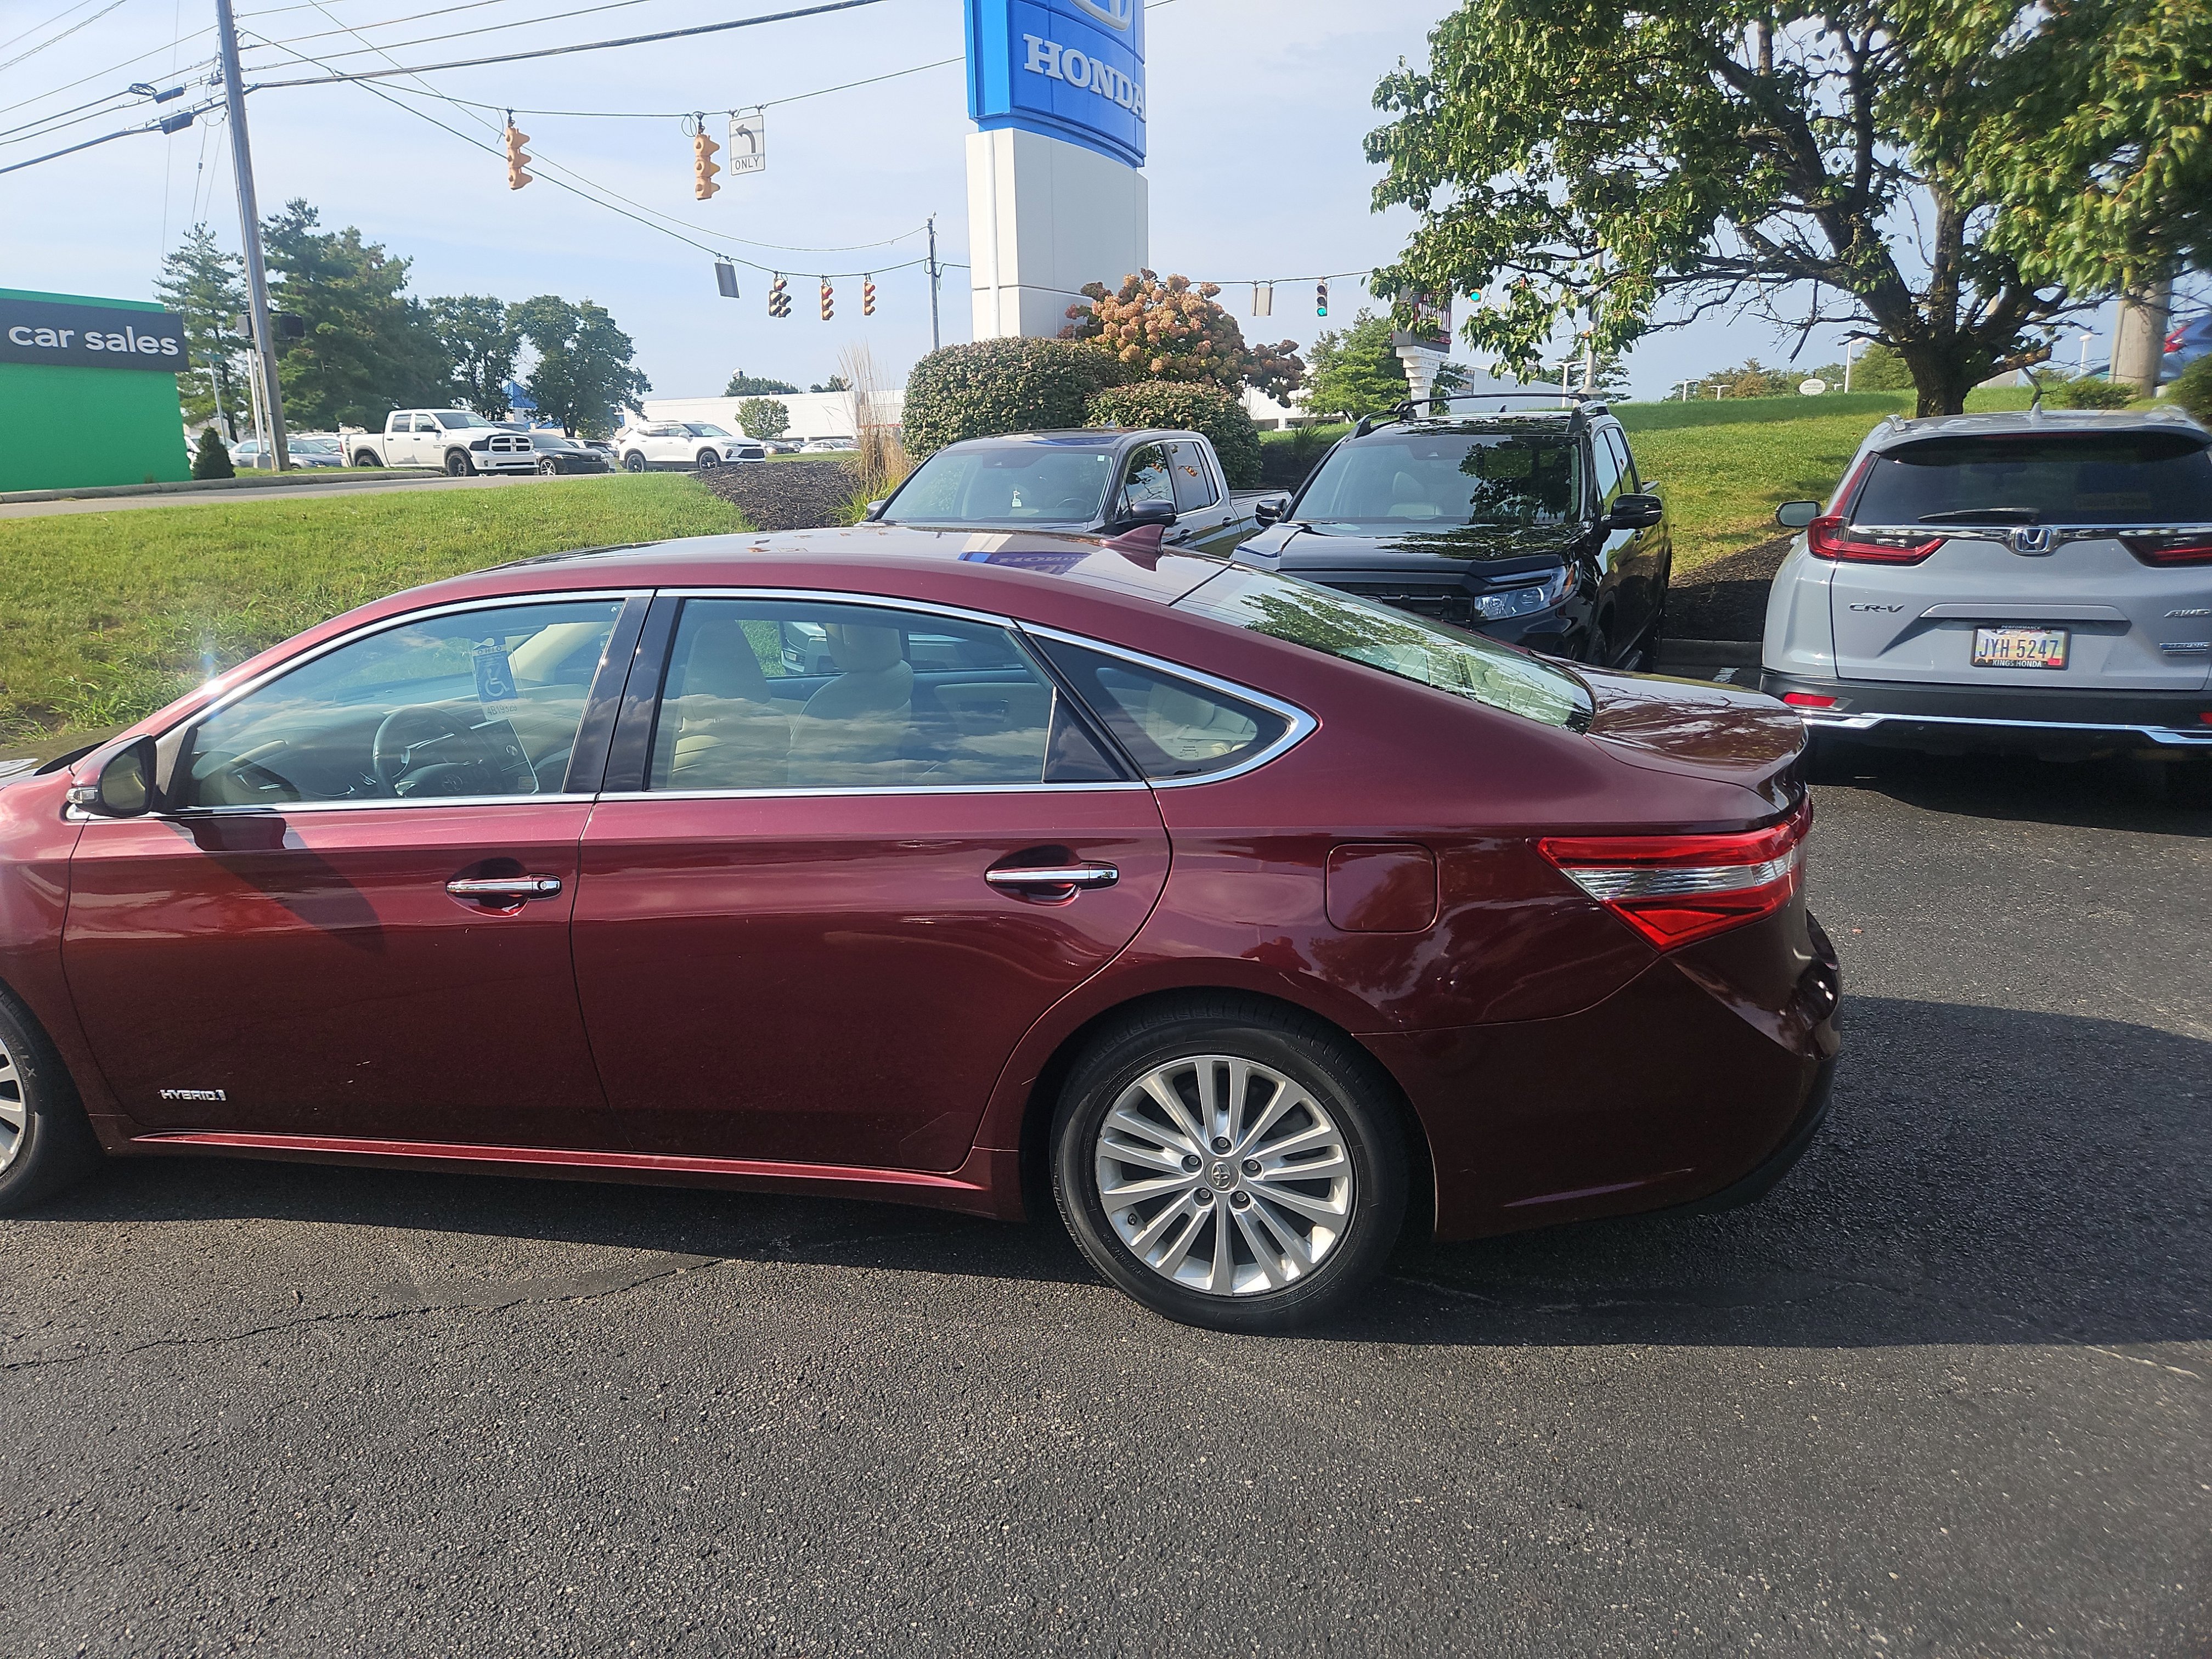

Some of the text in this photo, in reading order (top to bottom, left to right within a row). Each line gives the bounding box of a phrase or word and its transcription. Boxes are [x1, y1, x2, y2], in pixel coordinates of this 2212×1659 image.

[1023, 33, 1147, 123] HONDA
[735, 156, 759, 170] ONLY
[9, 326, 74, 348] car
[84, 326, 179, 356] sales
[1849, 603, 1905, 613] CR-V
[478, 646, 501, 654] OHIO
[1979, 639, 2058, 658] JYH 5247
[160, 1089, 216, 1101] HYBRID
